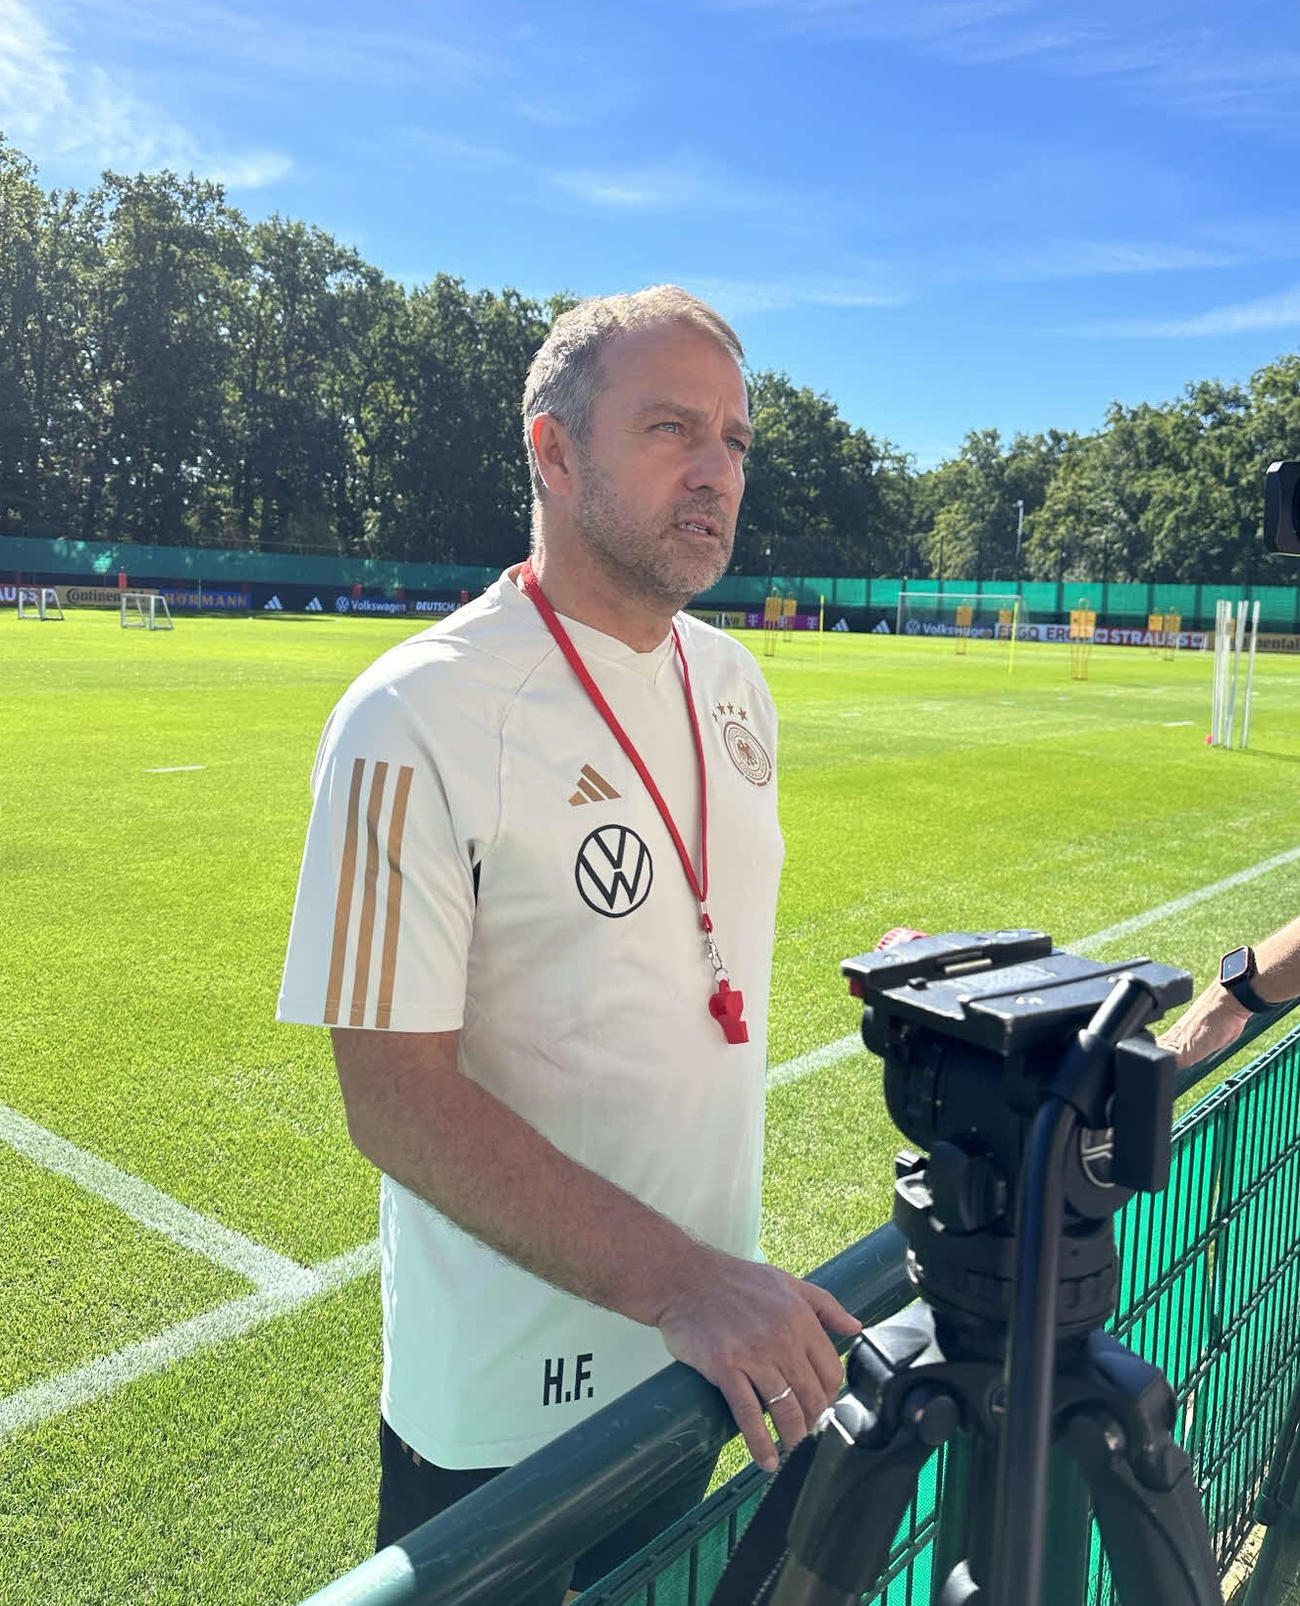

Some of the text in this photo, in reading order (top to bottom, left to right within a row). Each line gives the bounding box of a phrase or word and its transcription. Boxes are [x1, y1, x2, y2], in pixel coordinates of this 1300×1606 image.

[352, 600, 406, 613] Volkswagen
[1110, 629, 1188, 647] STRAUSS
[543, 1344, 594, 1406] H.F.
